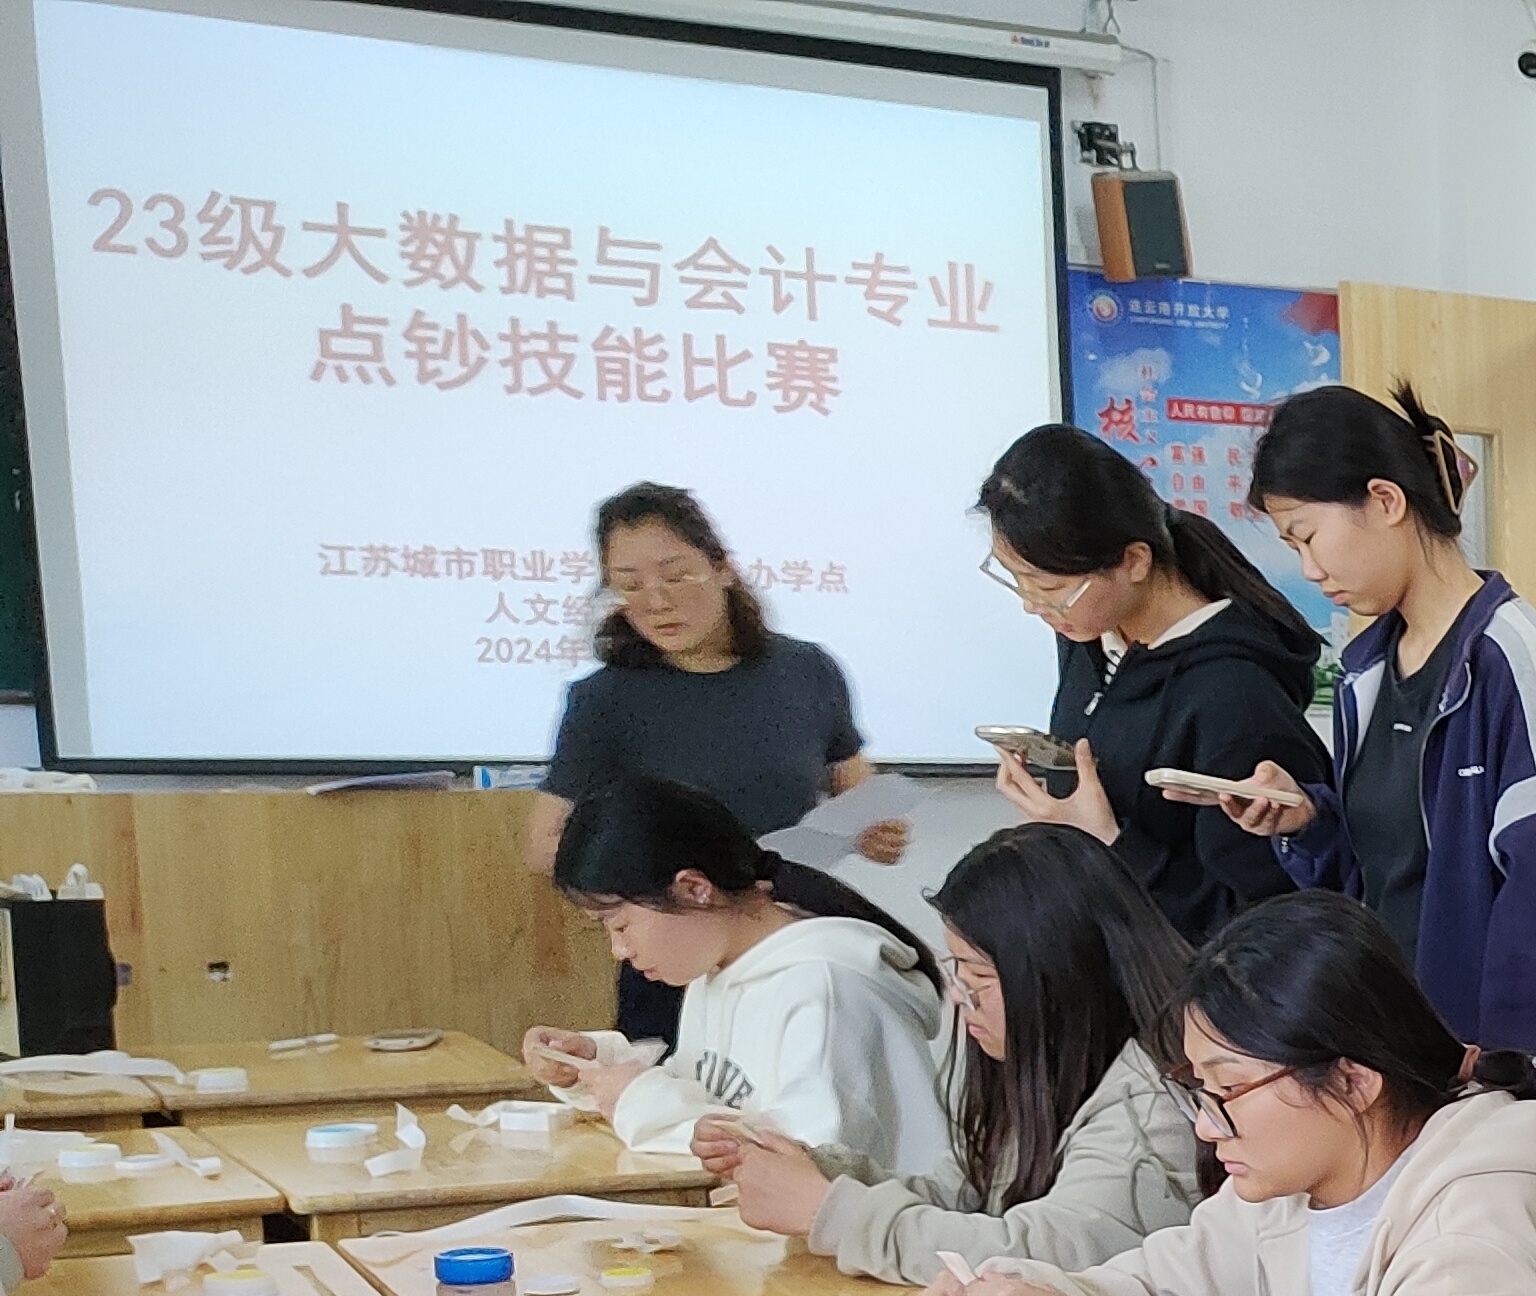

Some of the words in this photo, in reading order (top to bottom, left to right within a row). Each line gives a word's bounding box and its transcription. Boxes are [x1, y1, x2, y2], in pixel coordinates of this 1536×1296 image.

[87, 188, 1000, 334] 23级大数据与会计专业
[309, 303, 842, 417] 点钞技能比赛
